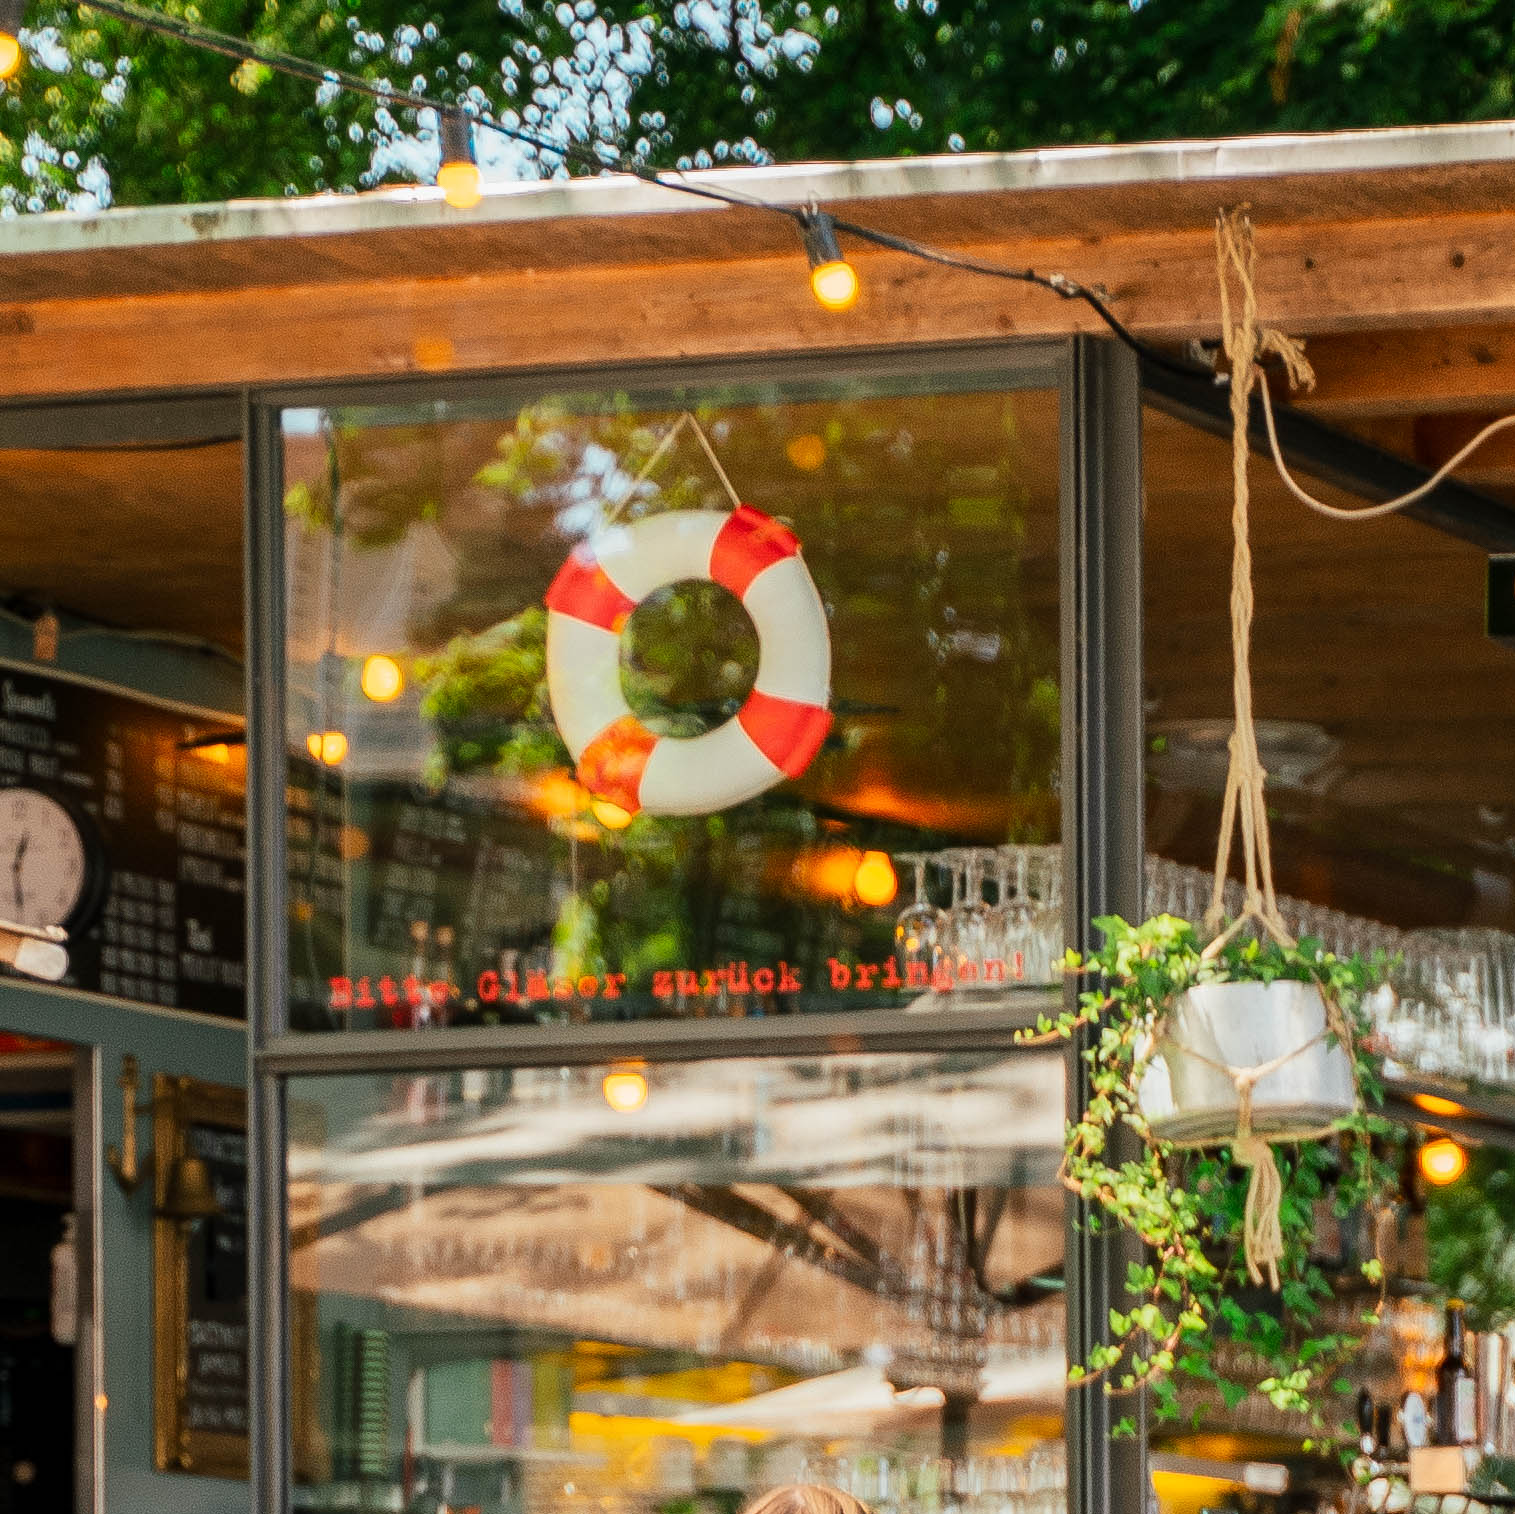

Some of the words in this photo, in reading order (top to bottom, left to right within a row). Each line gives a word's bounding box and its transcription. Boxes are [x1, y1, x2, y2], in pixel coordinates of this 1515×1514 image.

[330, 975, 458, 1009] Bitte
[478, 968, 627, 1001] Gläser
[652, 961, 801, 998] zurück
[828, 955, 1024, 989] bringen!
